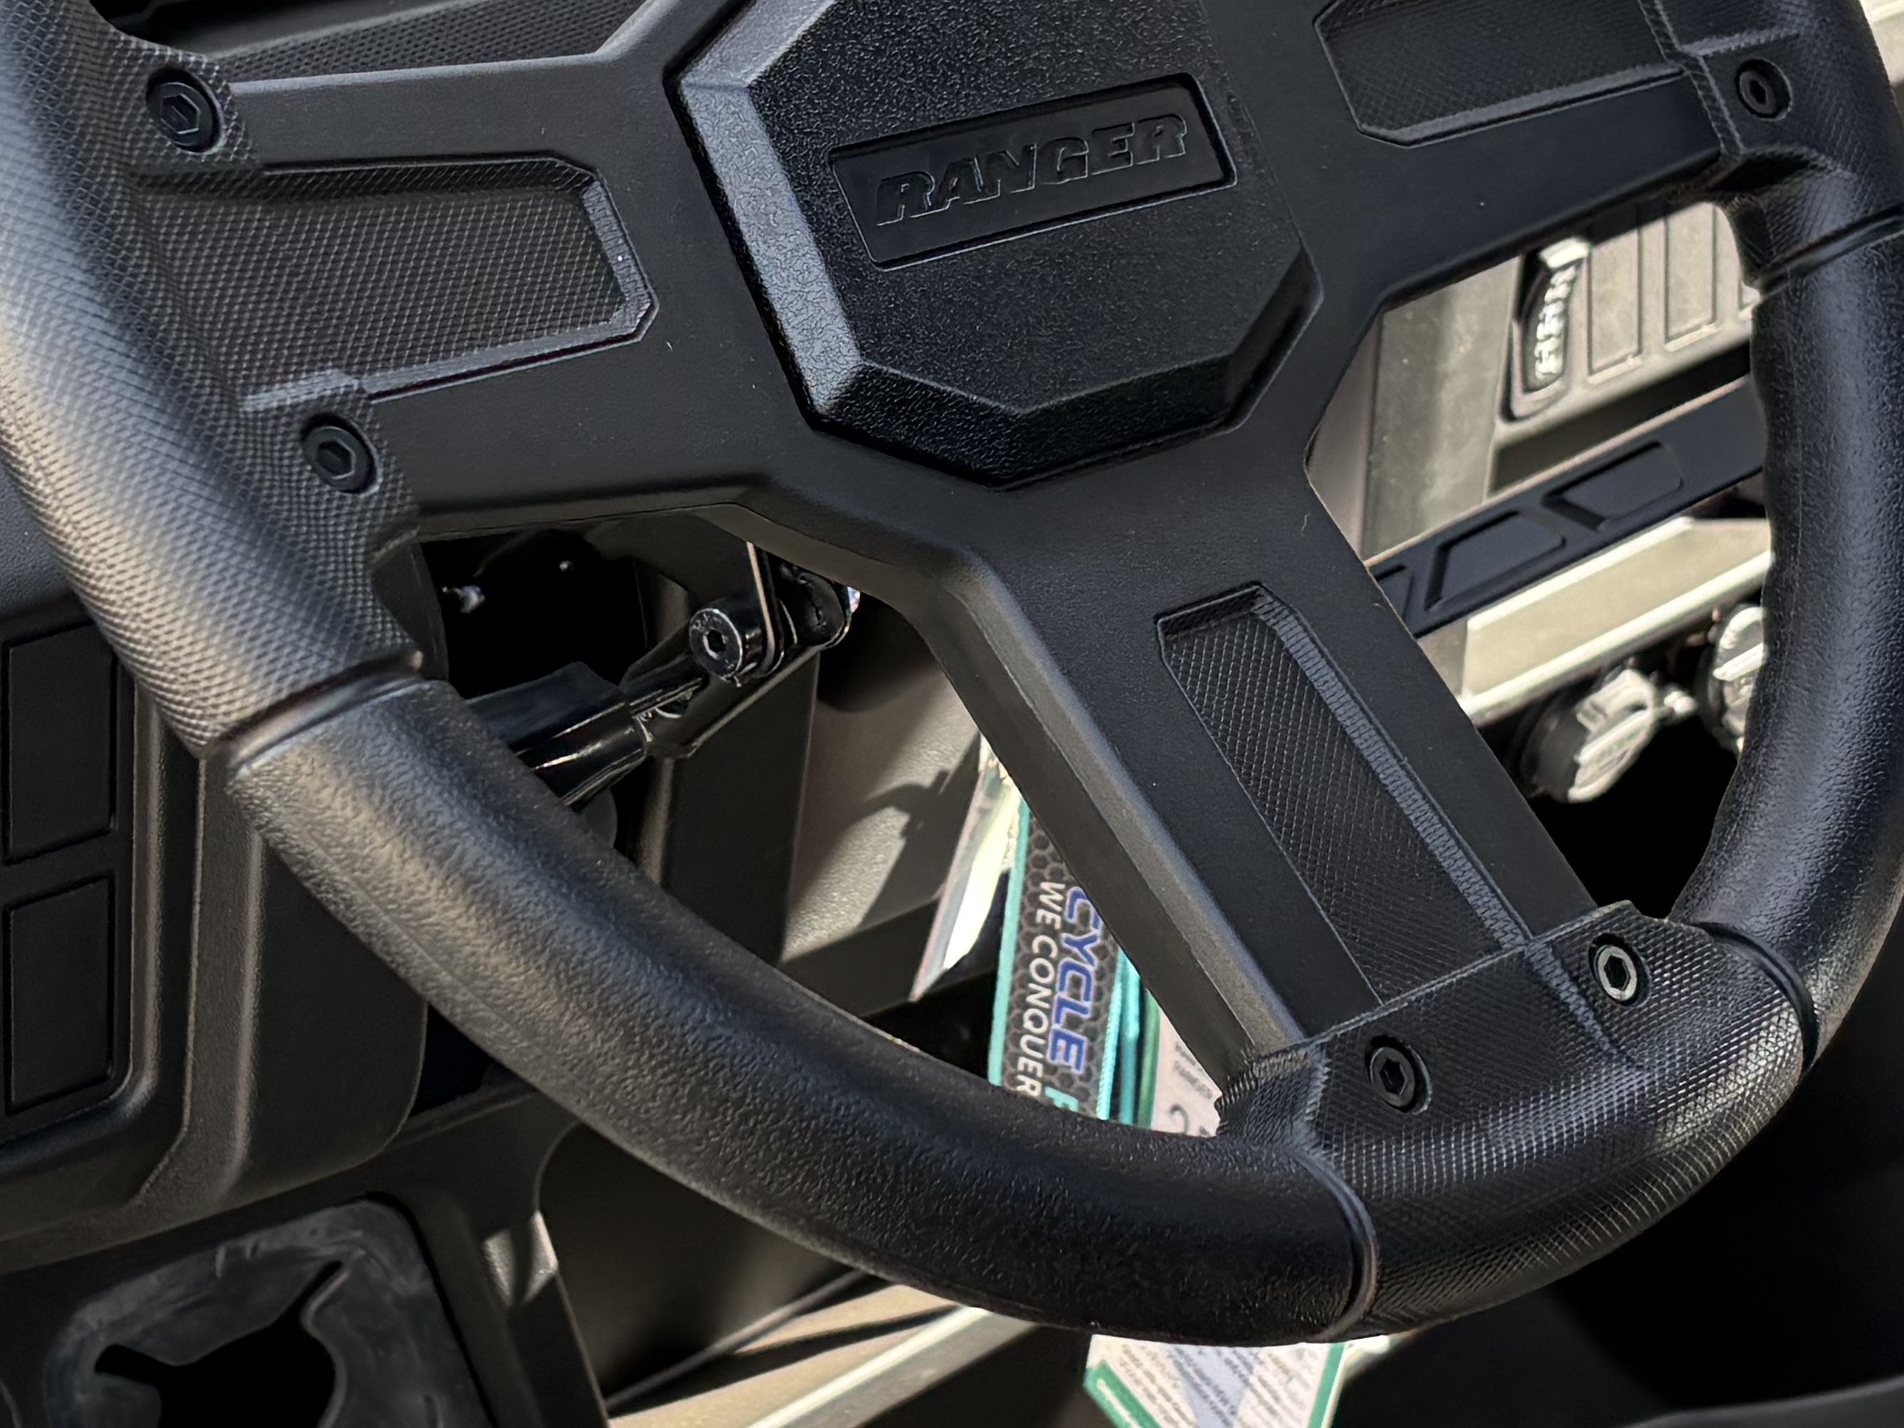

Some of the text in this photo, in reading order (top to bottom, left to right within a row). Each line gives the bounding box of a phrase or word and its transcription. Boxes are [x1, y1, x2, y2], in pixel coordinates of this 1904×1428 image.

[876, 112, 1188, 227] RANGER
[1015, 881, 1067, 1099] WE CONQUER
